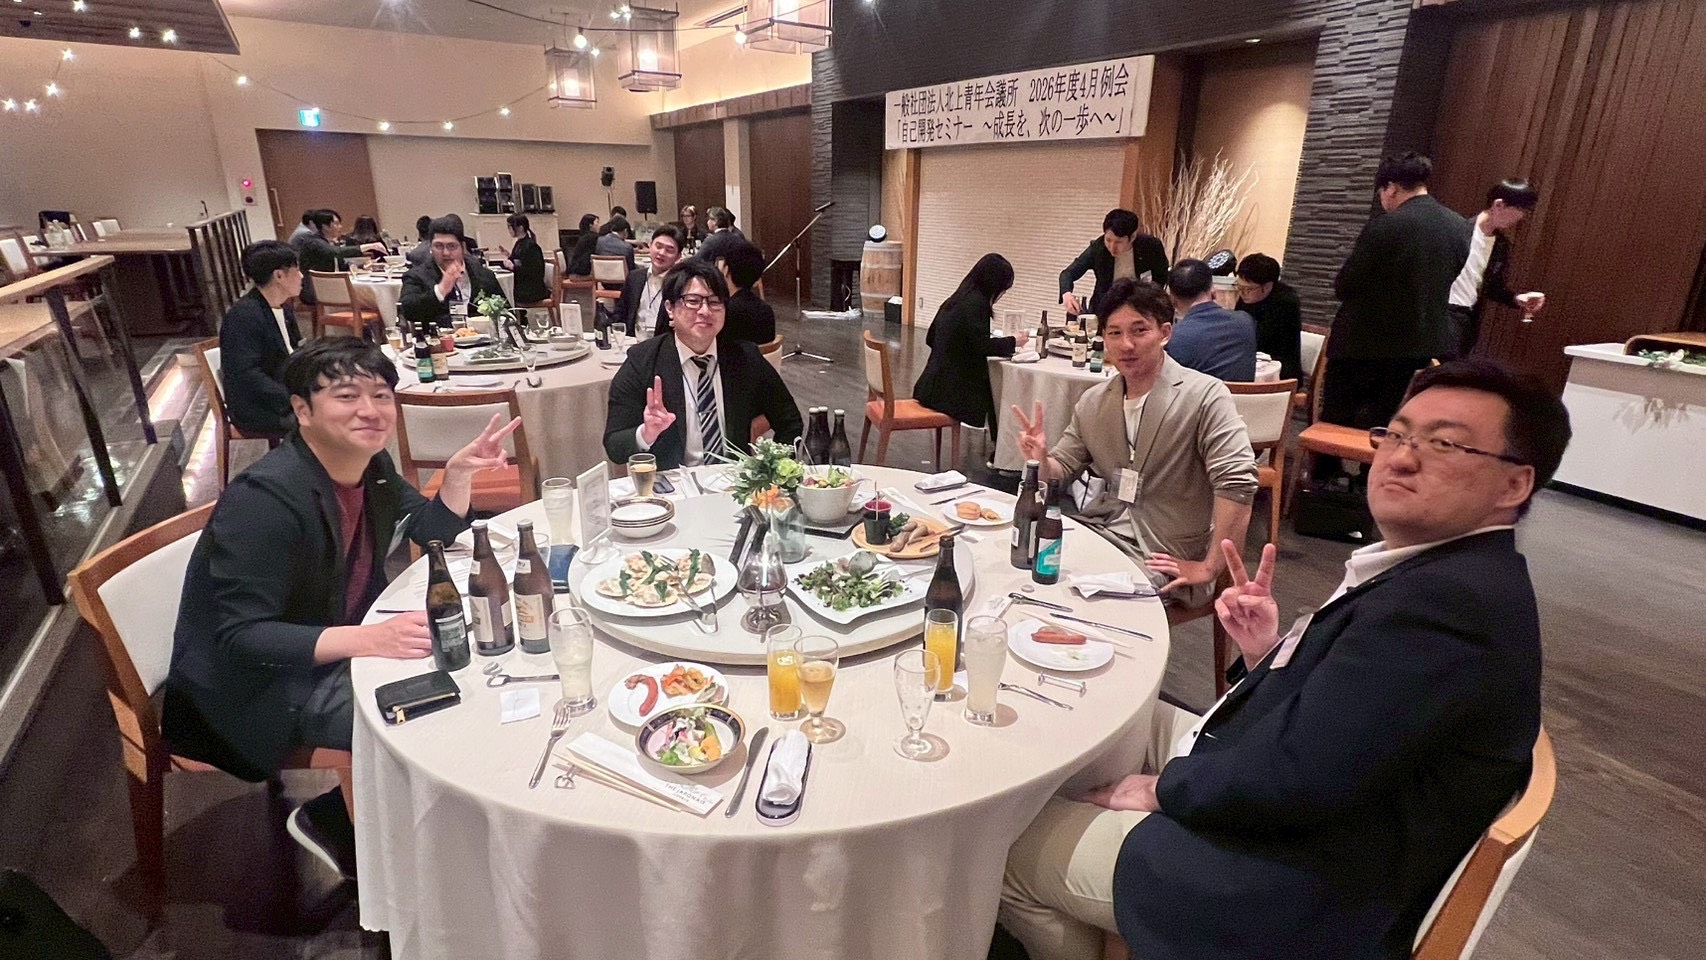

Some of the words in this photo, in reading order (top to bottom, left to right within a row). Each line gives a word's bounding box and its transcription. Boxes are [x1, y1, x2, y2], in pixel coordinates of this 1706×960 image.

[894, 78, 1019, 117] 一般社団法人北上青年会議所
[1029, 63, 1129, 103] 2026年度4月例会
[897, 115, 973, 143] 「自己開発セミナー
[665, 783, 676, 791] THE
